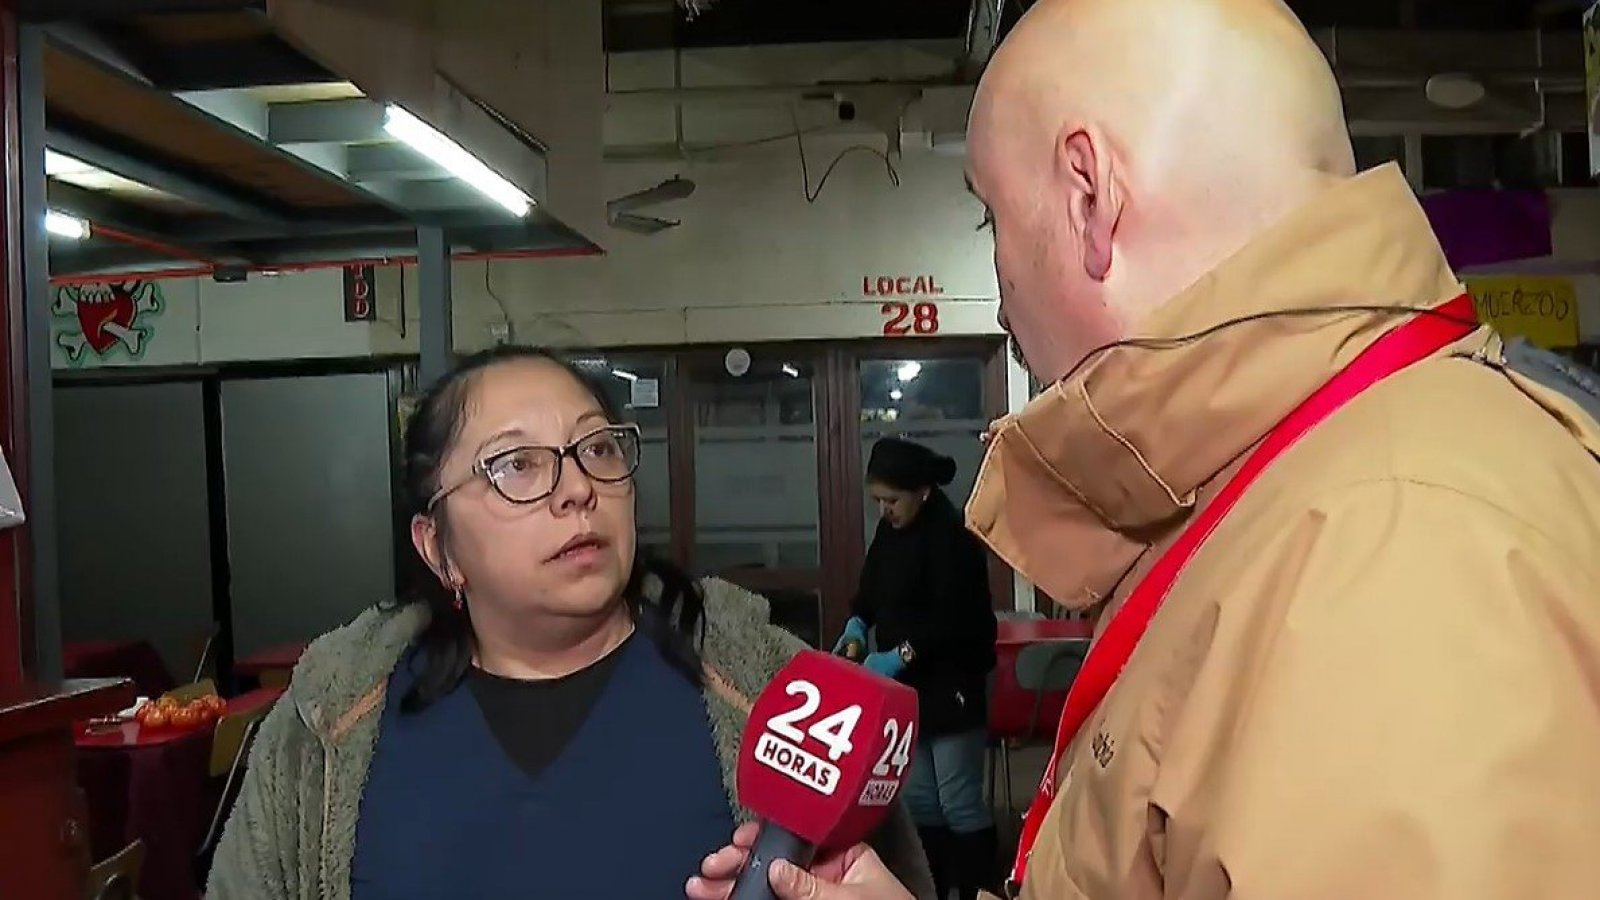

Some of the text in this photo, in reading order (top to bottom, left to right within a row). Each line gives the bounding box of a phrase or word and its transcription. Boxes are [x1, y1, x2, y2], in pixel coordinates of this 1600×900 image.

[863, 275, 945, 295] LOCAL
[881, 302, 939, 337] 28
[767, 679, 862, 760] 24
[762, 739, 831, 787] HORAS
[872, 718, 913, 777] 24
